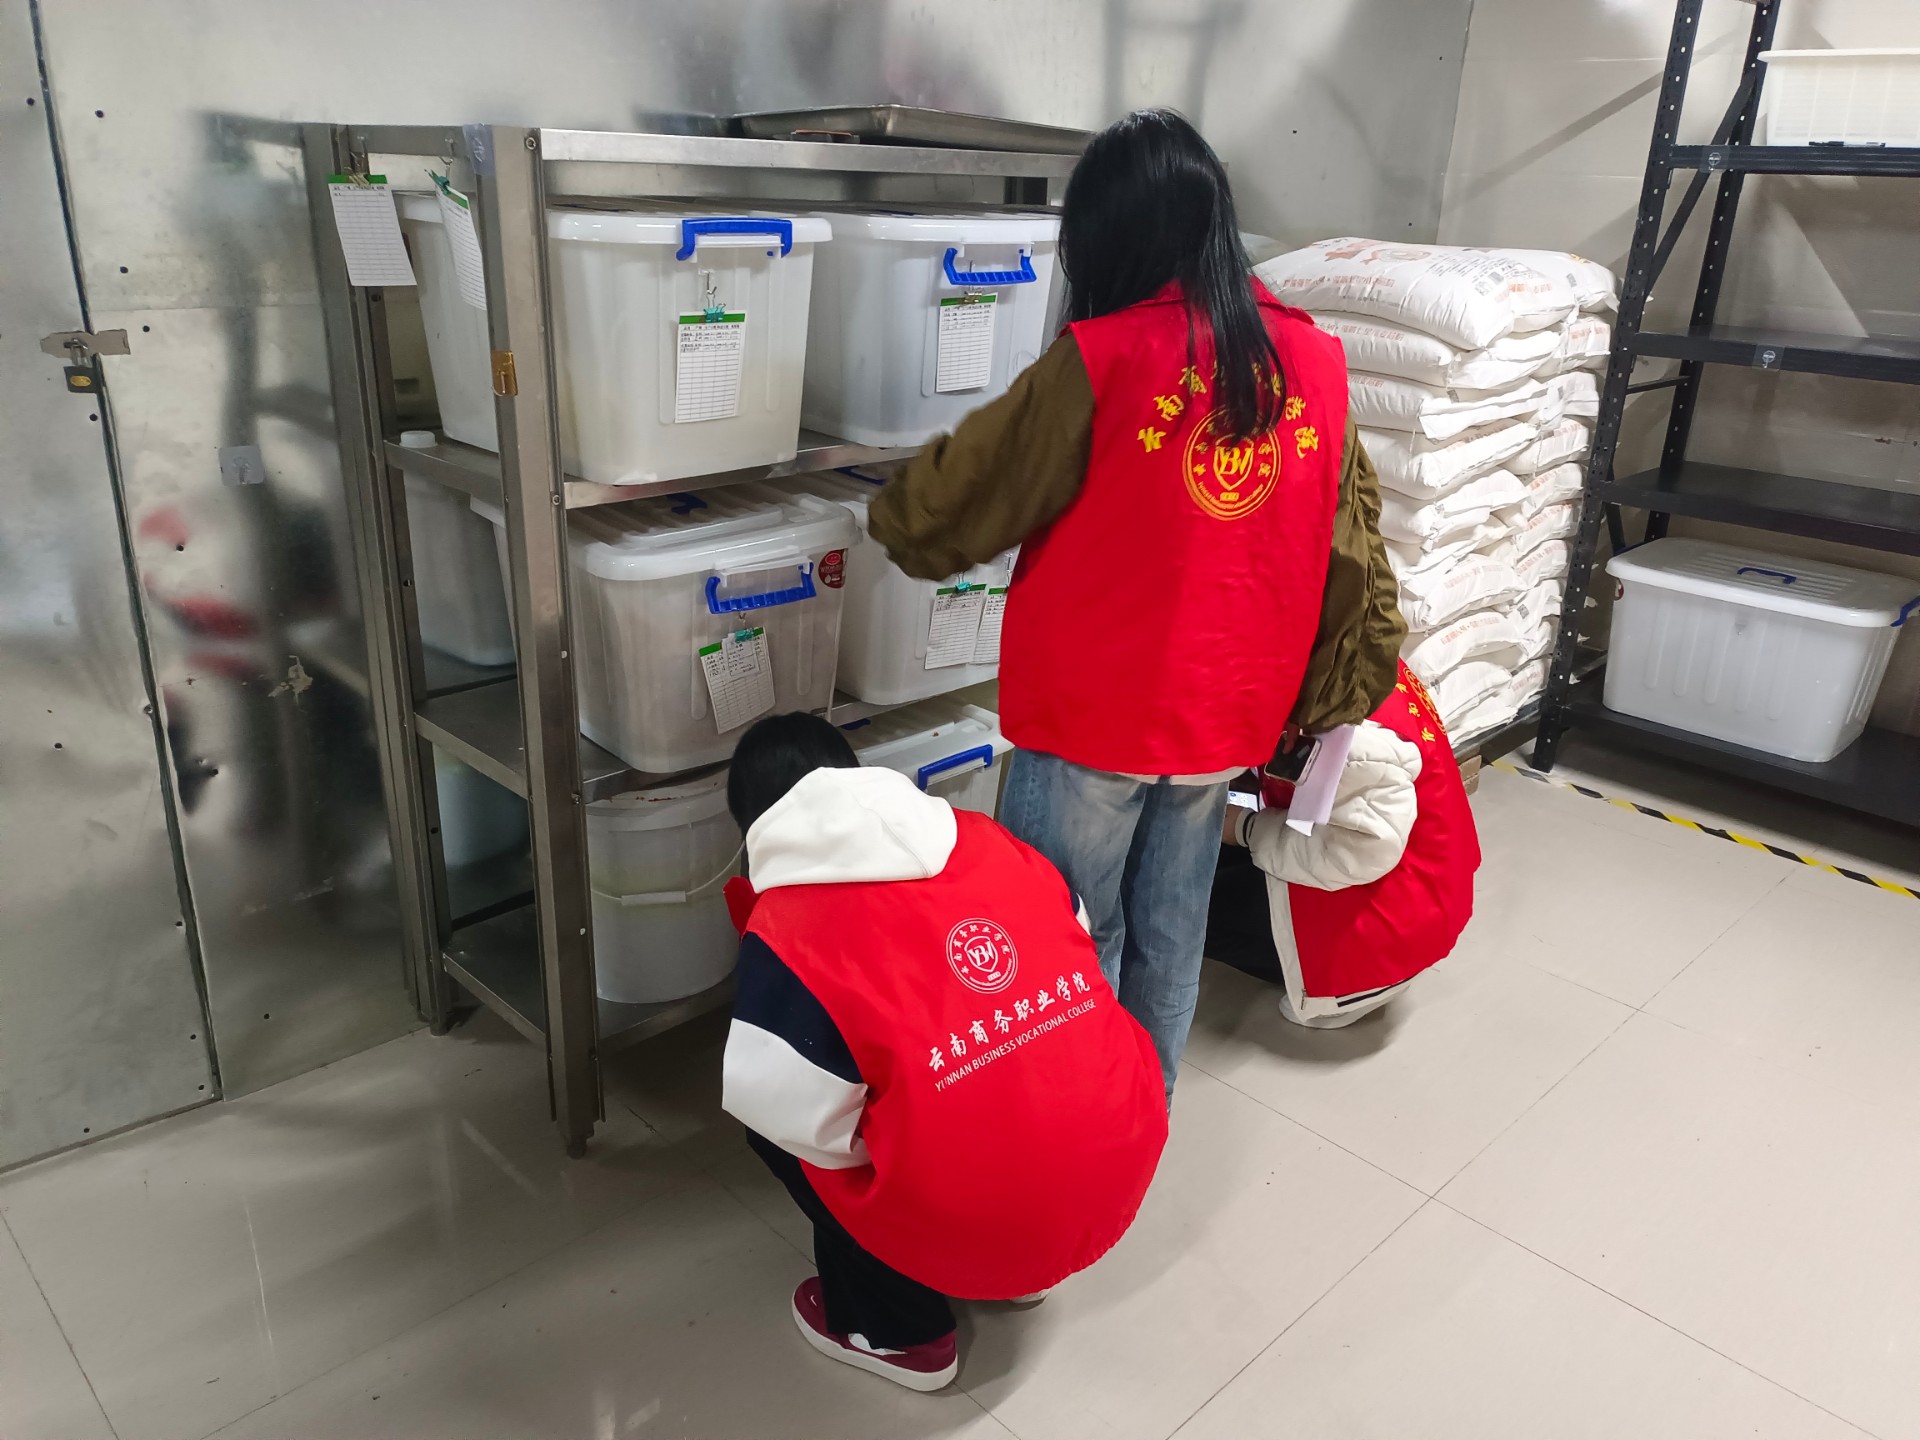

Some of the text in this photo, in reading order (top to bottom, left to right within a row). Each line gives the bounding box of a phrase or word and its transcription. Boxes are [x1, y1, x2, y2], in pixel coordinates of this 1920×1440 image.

[929, 971, 1091, 1072] 云南商务职业学院
[972, 1040, 1017, 1070] BUSINESS
[1015, 1013, 1069, 1046] VOCATIONAL
[1067, 999, 1097, 1019] COLLEGE
